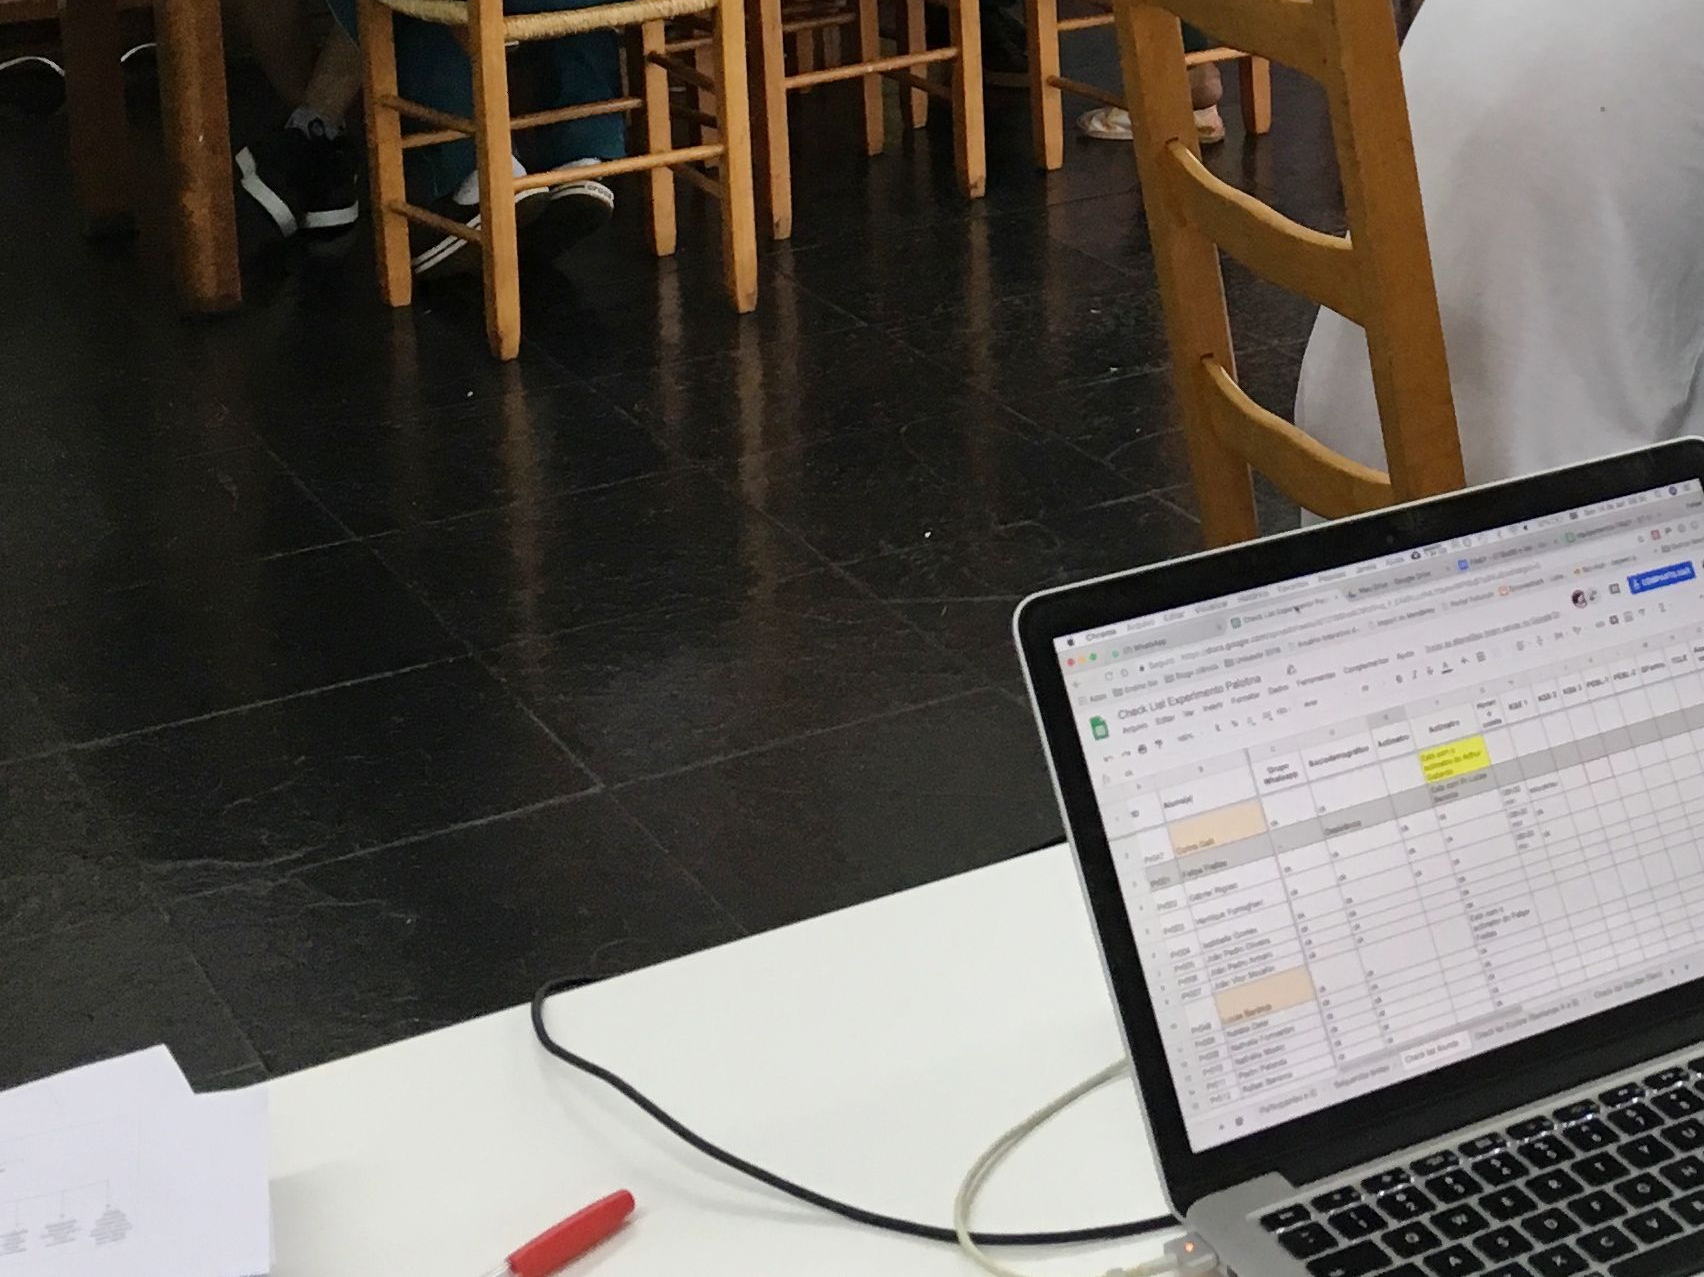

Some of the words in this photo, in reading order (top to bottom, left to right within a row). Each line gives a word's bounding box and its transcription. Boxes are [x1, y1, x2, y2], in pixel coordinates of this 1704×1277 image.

[1116, 703, 1147, 720] Check
[1148, 698, 1167, 712] List
[1166, 682, 1225, 709] Experimento
